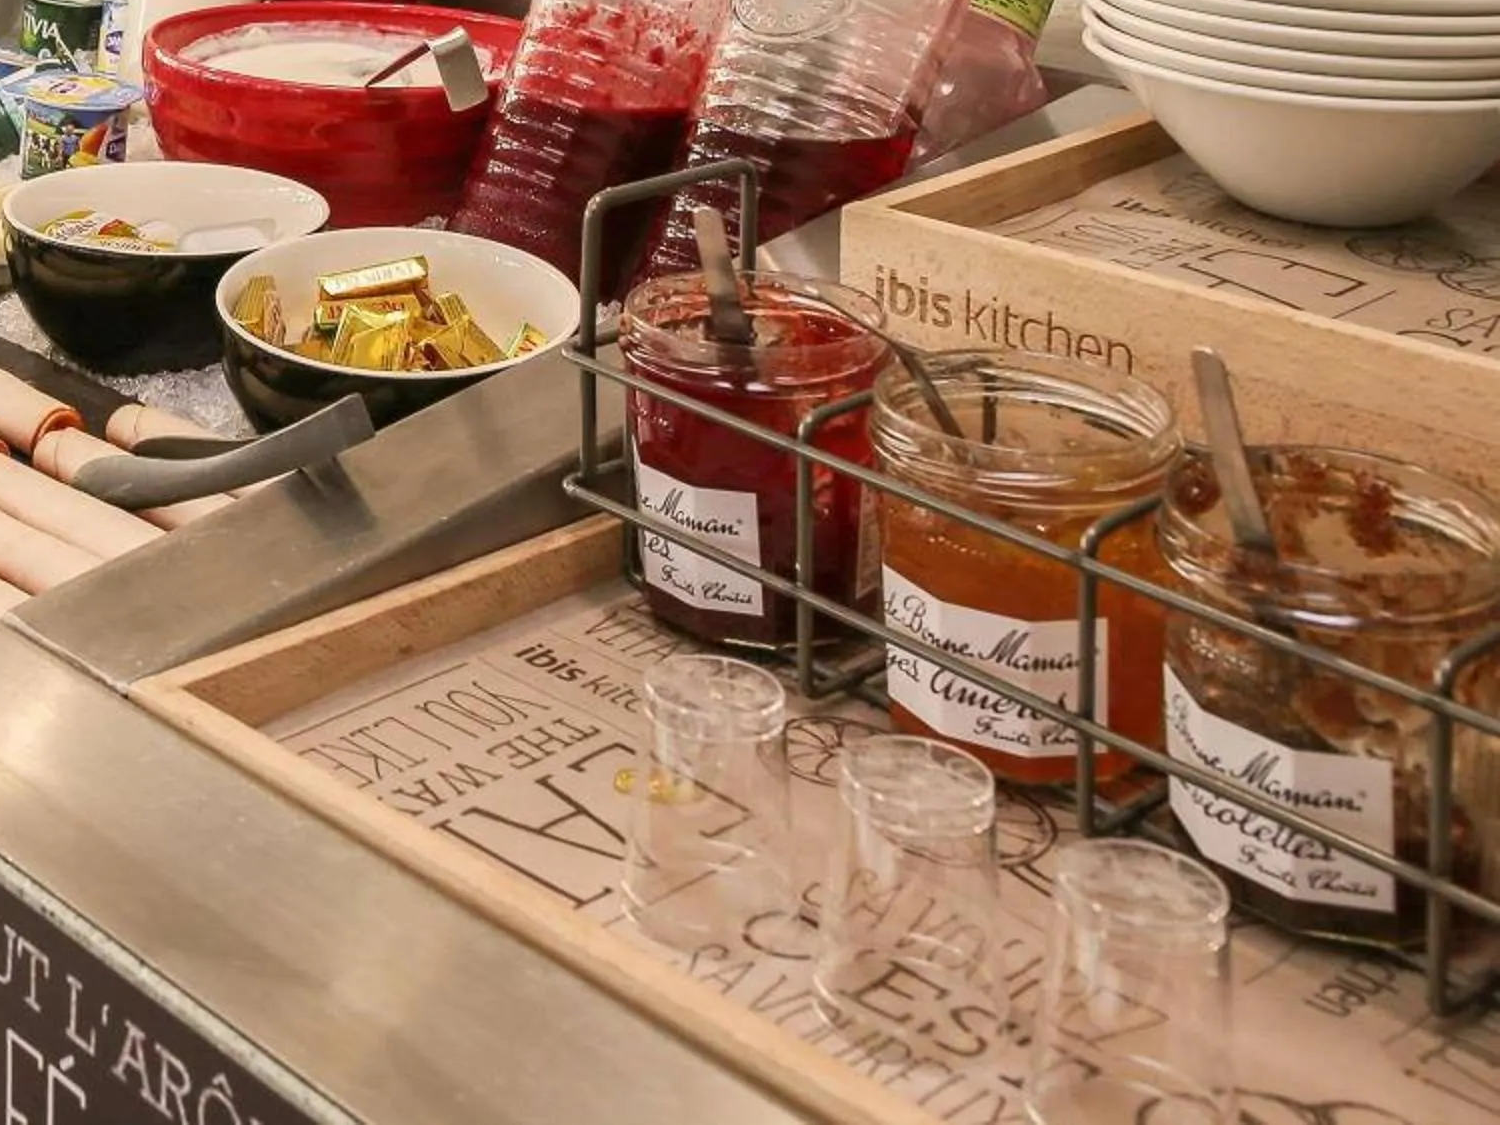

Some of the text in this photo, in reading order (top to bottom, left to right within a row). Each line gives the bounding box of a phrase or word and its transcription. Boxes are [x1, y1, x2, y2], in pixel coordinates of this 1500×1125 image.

[875, 264, 1133, 376] ibis kitchen
[513, 641, 644, 714] ibis kitc
[977, 629, 1082, 673] Mama
[65, 975, 266, 1125] L'ARÔ
